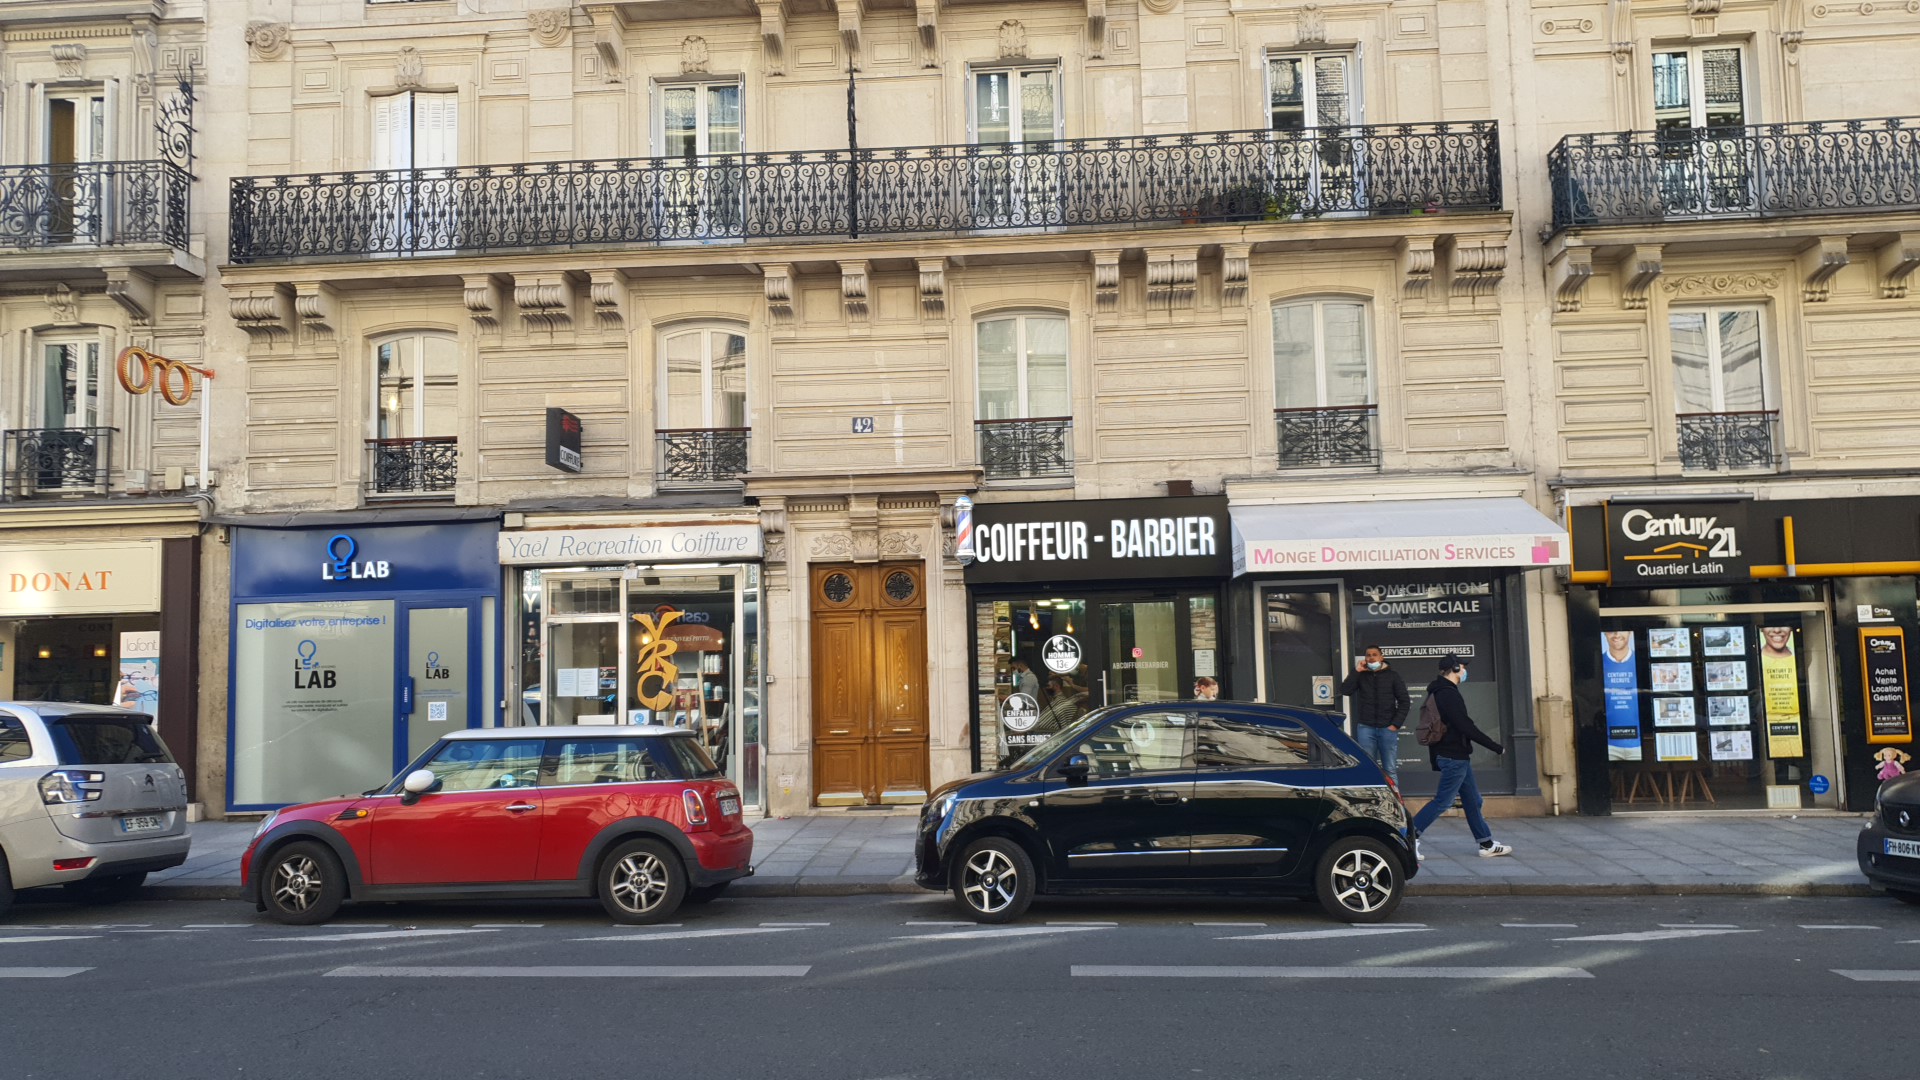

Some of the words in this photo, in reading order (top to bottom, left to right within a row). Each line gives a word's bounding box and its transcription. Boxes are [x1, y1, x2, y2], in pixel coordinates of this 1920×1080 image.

[854, 417, 872, 433] 42
[975, 520, 1089, 563] COIFFEUR
[1111, 516, 1216, 559] BARBIER
[1621, 508, 1717, 541] Century
[1707, 527, 1737, 558] 21
[558, 533, 663, 557] Recreation
[671, 531, 749, 558] Coiffure
[351, 560, 389, 579] LAB
[1637, 562, 1689, 576] Quartier
[1692, 561, 1724, 574] Latin
[9, 570, 112, 593] DONAT
[1362, 581, 1482, 596] DOMICILIATION
[1367, 600, 1480, 615] COMMERCIALE
[245, 618, 297, 630] Digitalisez
[299, 617, 326, 627] votre
[328, 616, 380, 629] entreprise
[126, 637, 159, 652] lafont
[1381, 647, 1411, 656] SERVICES
[1413, 647, 1428, 655] AUX
[1429, 646, 1471, 655] ENTREPRISES
[1048, 652, 1076, 660] HOMME
[1056, 660, 1069, 669] 13€
[426, 668, 450, 679] LAB
[1875, 668, 1897, 676] Achat
[294, 670, 337, 689] LAB
[1875, 676, 1898, 685] Vente
[1871, 685, 1903, 693] Location
[1873, 694, 1902, 702] Gestion
[1006, 709, 1035, 717] ENFANT
[1008, 735, 1026, 744] SANS
